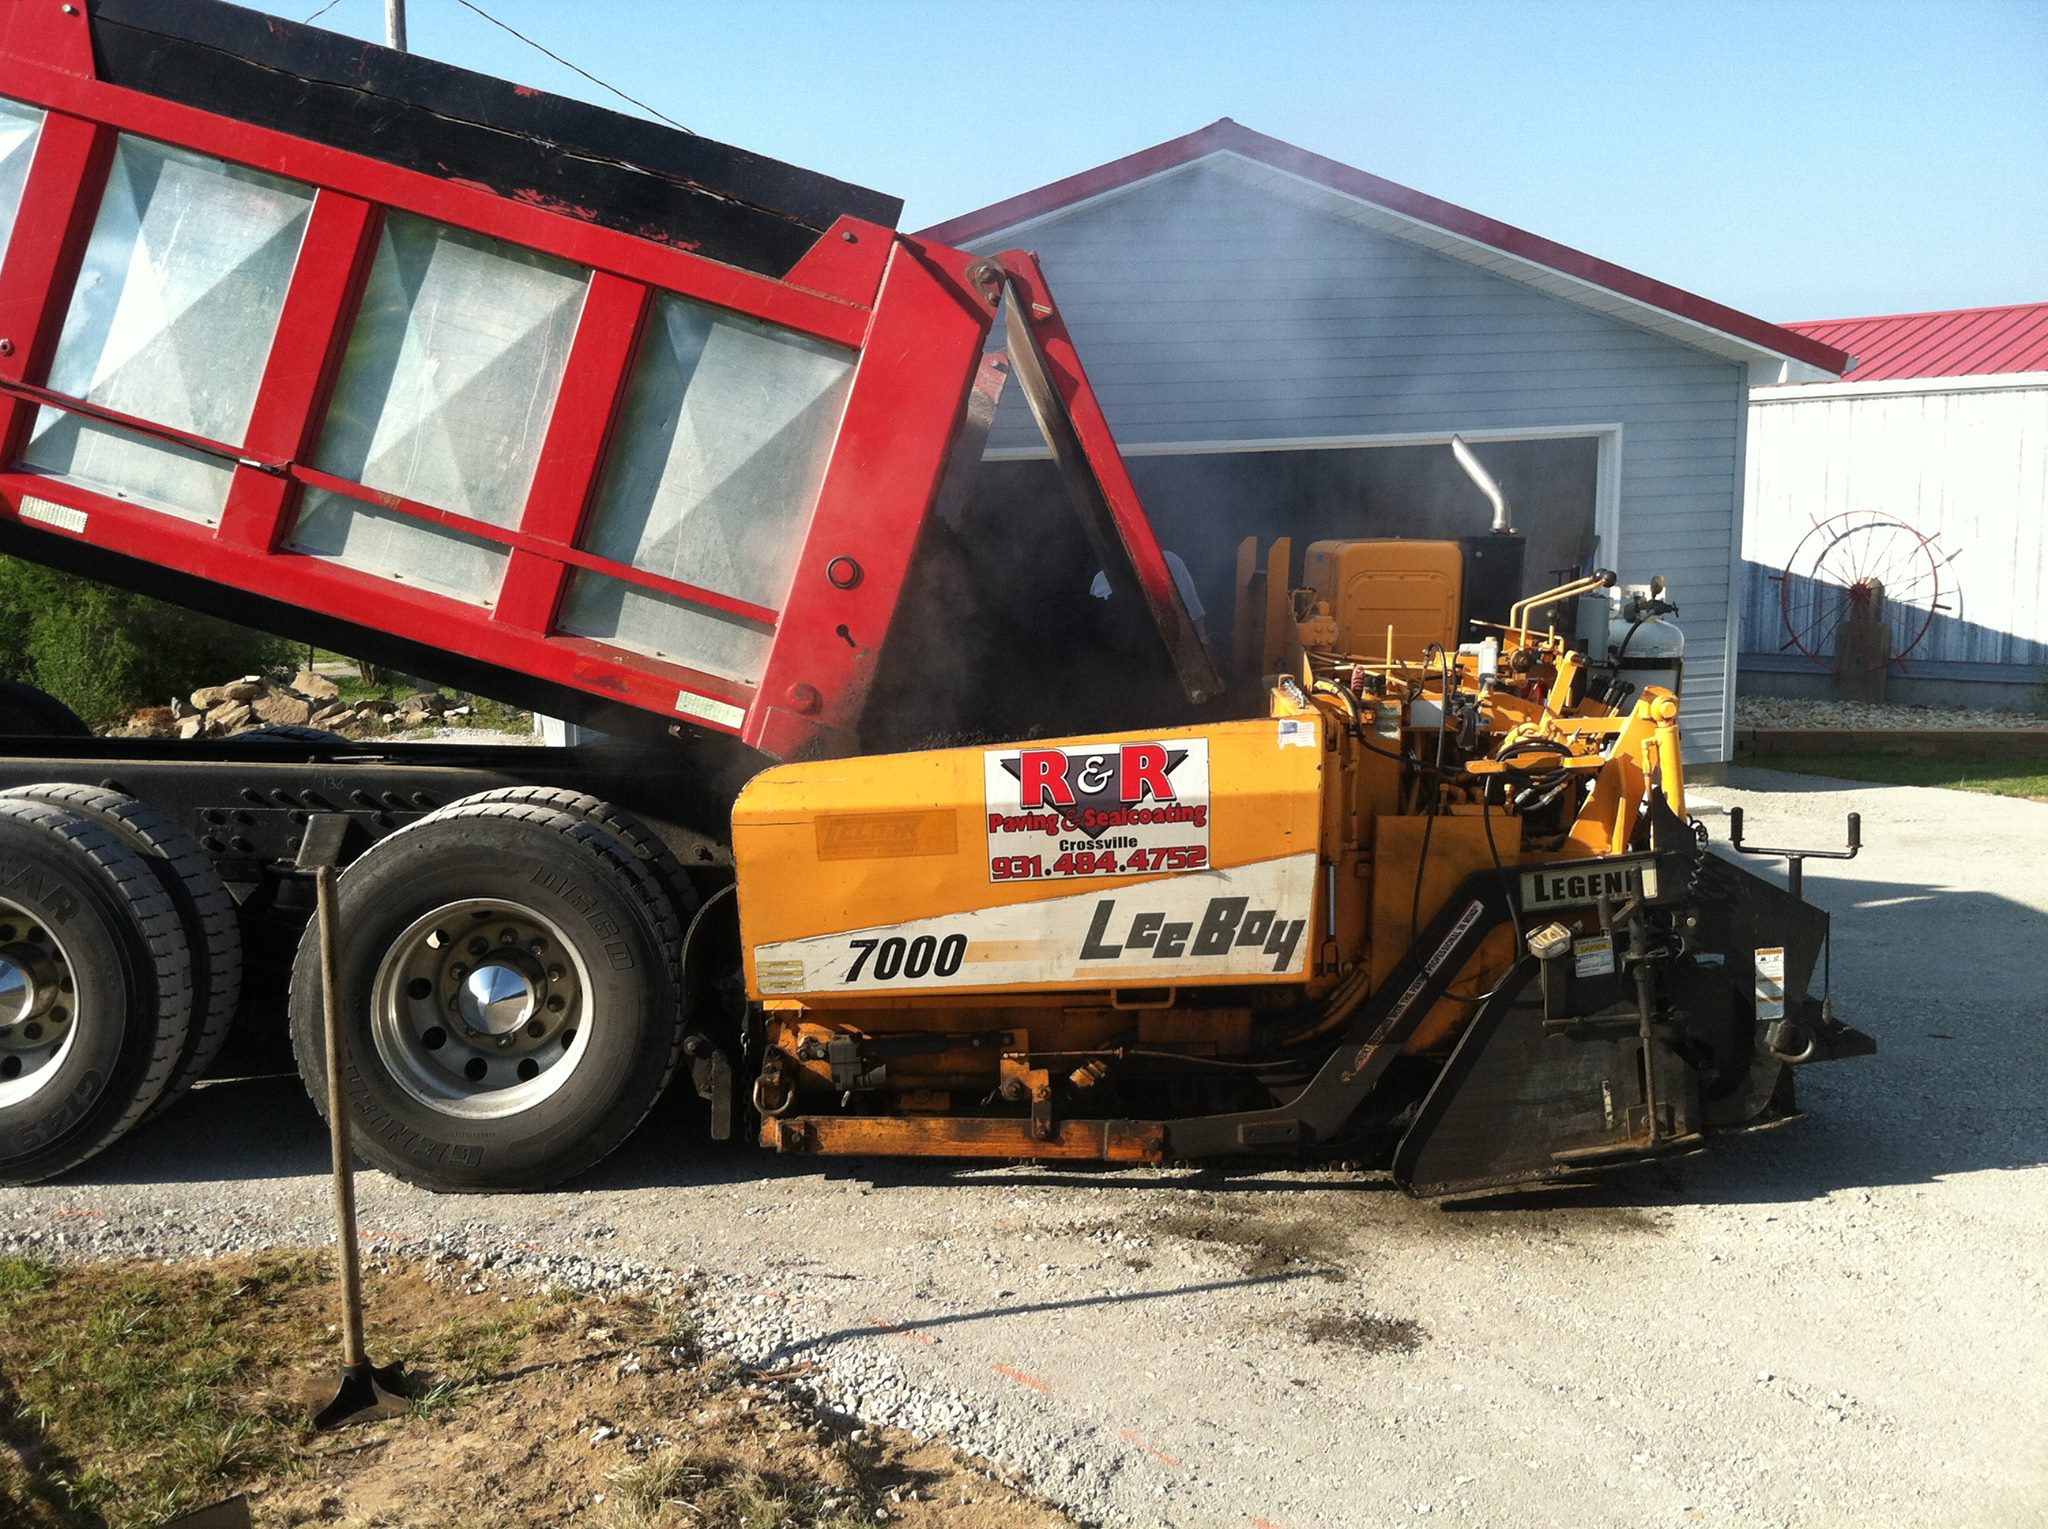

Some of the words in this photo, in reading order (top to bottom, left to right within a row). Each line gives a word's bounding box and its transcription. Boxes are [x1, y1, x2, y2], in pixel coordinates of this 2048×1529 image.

[989, 812, 1059, 836] Paving
[1083, 803, 1207, 828] Sealcoating
[1059, 836, 1138, 852] Crossville
[991, 845, 1208, 880] 931.484.4752
[1079, 896, 1307, 972] LeeBoy
[845, 933, 968, 982] 7000
